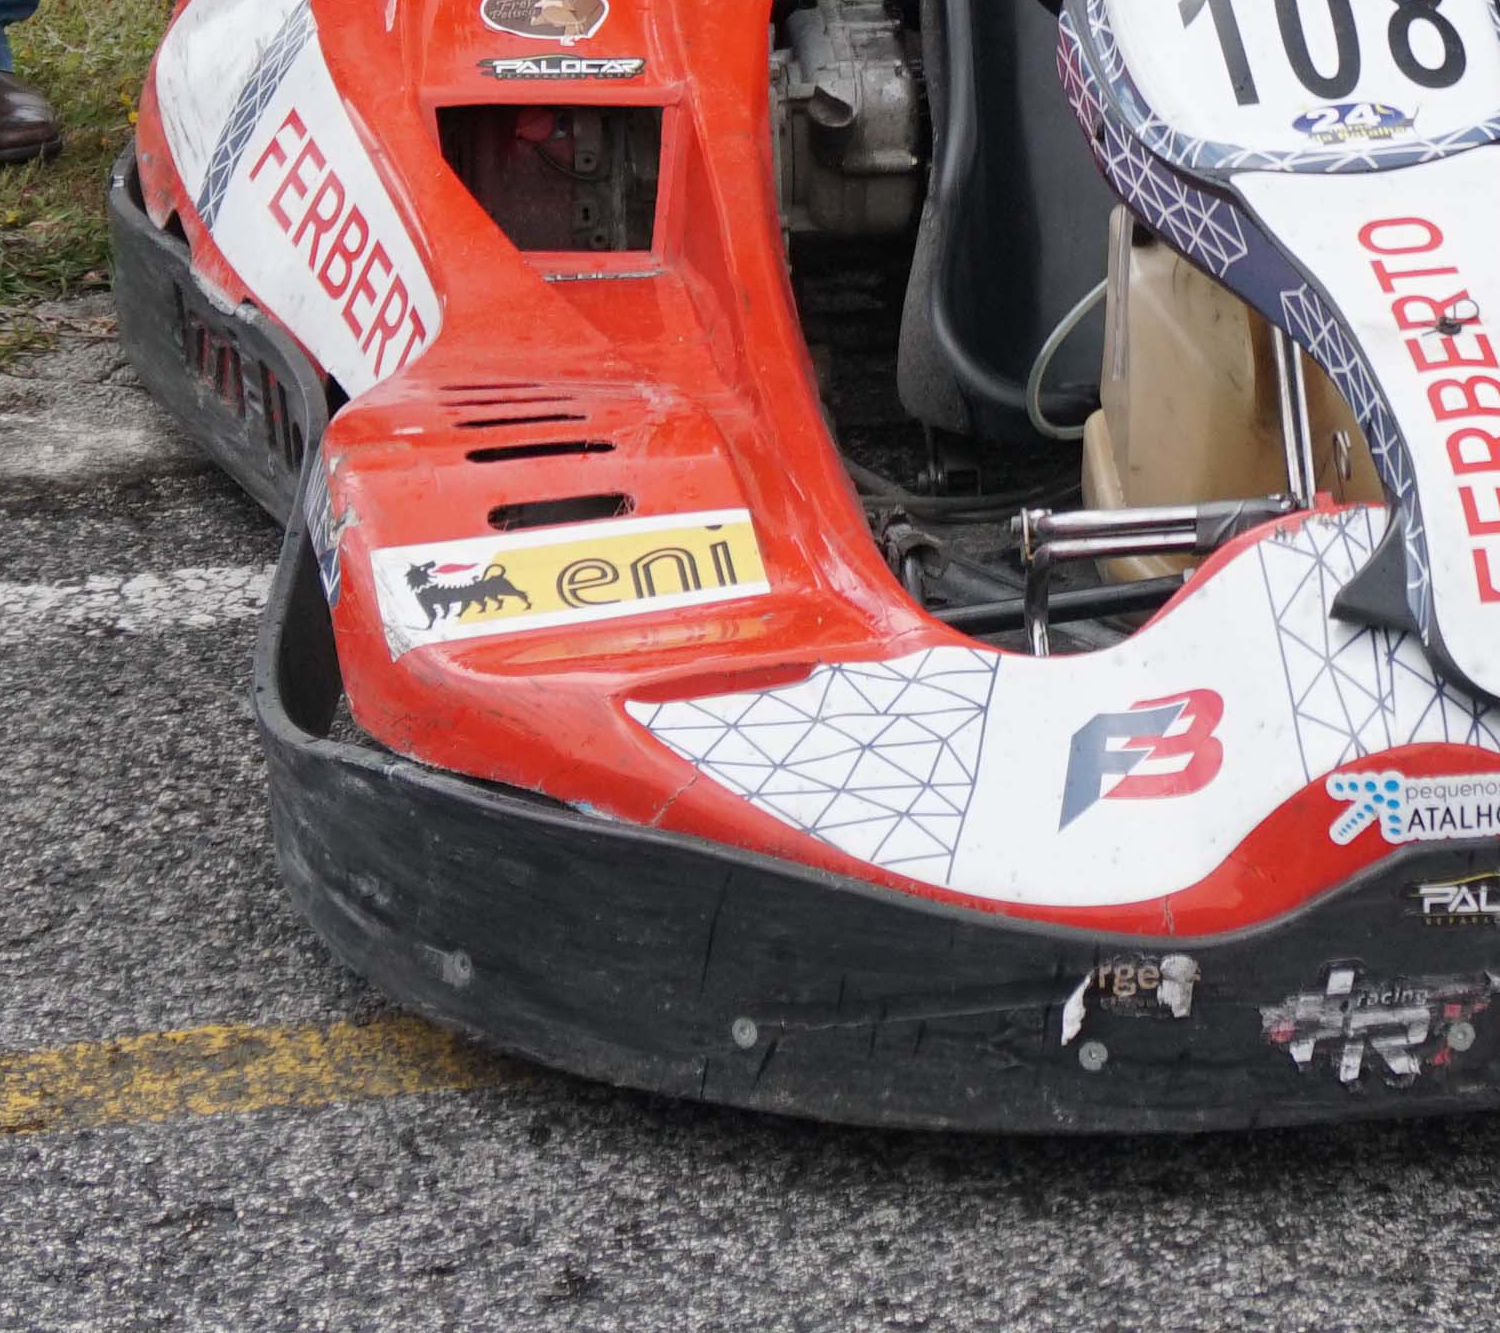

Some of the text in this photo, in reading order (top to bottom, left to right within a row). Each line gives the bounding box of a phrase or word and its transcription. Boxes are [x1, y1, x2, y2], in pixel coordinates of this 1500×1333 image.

[492, 59, 644, 74] PALOCAR
[1305, 101, 1382, 133] 24
[249, 107, 426, 378] FERBERT
[555, 523, 738, 610] eni
